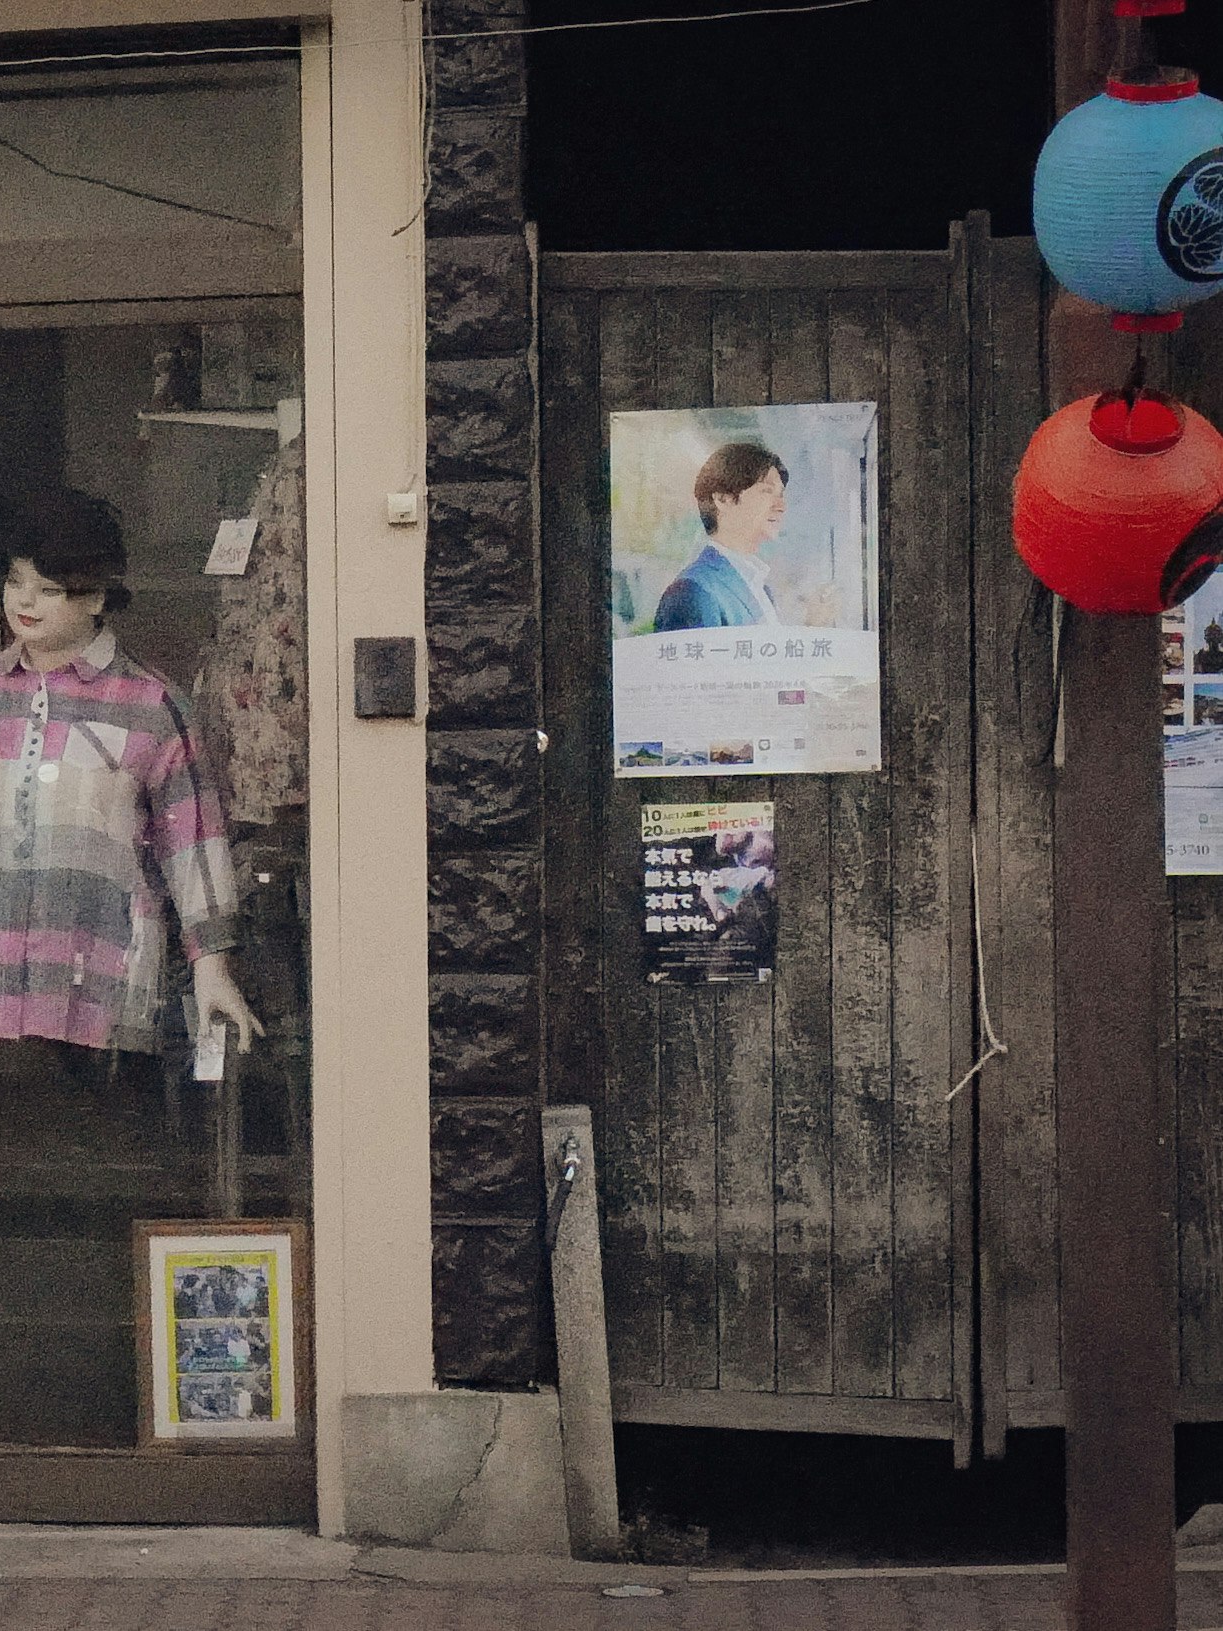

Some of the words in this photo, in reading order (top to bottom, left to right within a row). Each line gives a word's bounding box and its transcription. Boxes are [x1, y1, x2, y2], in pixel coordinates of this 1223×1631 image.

[658, 638, 834, 661] 地球一周の船旅
